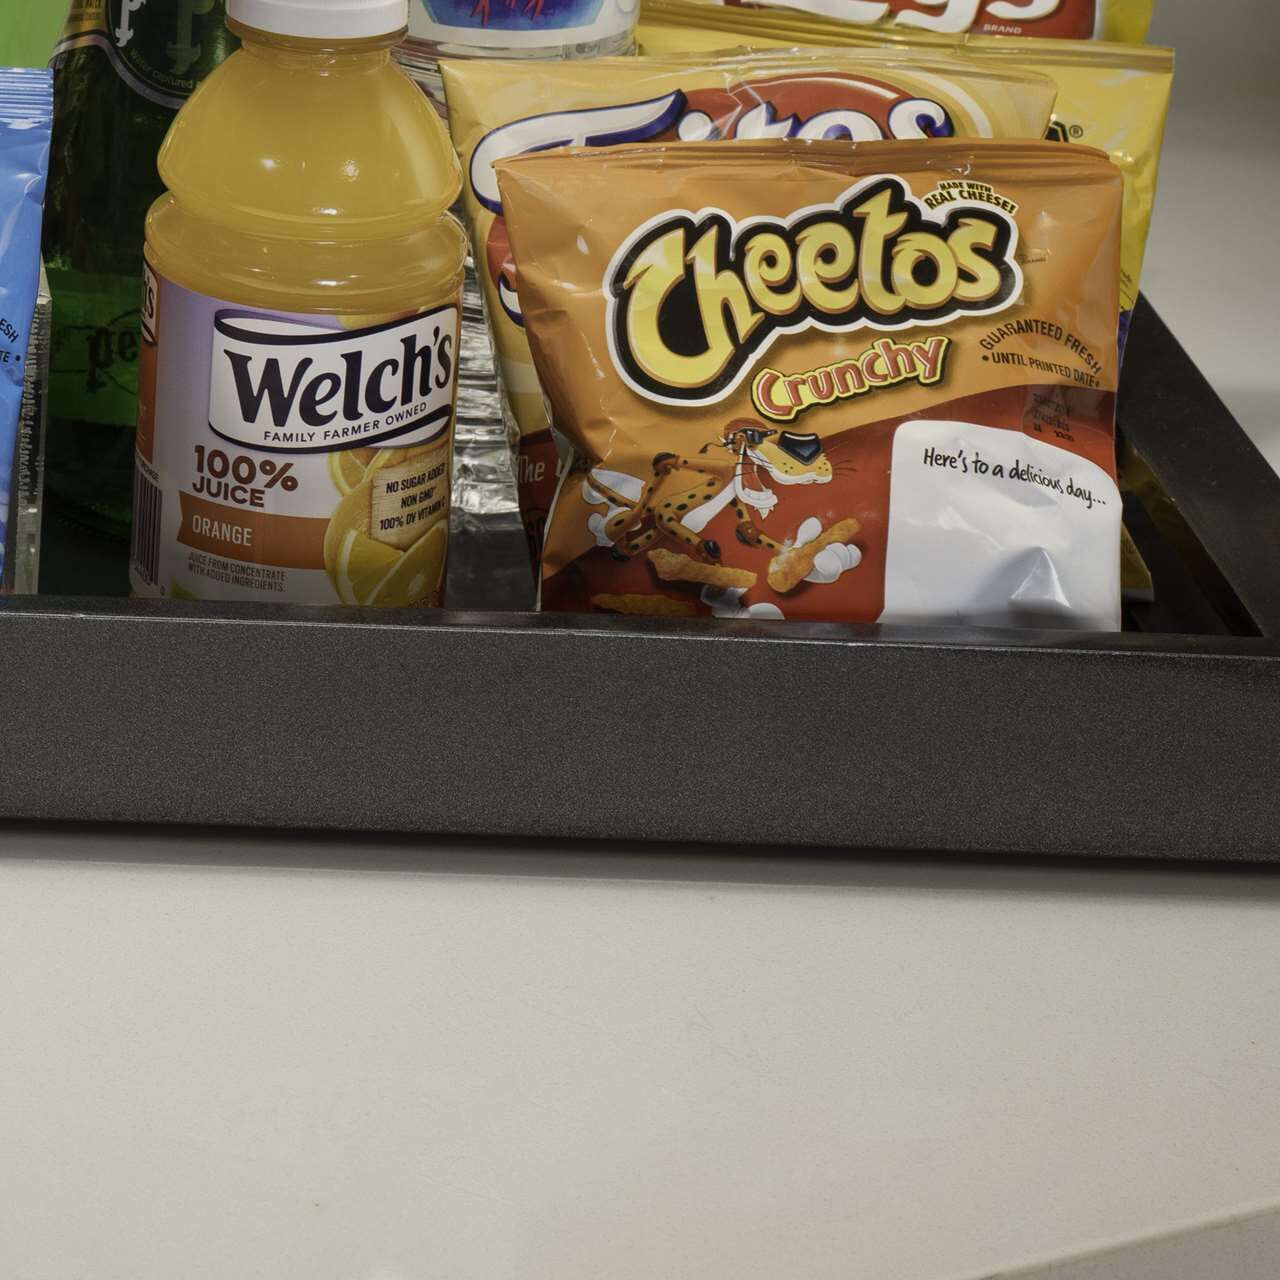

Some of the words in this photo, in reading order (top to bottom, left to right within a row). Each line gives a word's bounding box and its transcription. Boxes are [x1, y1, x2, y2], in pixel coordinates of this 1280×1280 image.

[982, 23, 1023, 35] BRAND
[924, 191, 957, 210] REAL
[958, 189, 1017, 214] CHEESE!
[939, 182, 965, 191] MADE
[966, 182, 992, 193] WITH
[623, 186, 1004, 388] Cheetos
[979, 319, 1063, 351] GUARANTEED
[1064, 332, 1102, 375] FRESH
[224, 325, 452, 427] Welch's
[756, 336, 947, 416] Crunchy
[992, 354, 1027, 367] UNTIL
[1028, 357, 1072, 378] PRINTED
[1073, 369, 1095, 386] DATE
[263, 430, 316, 443] FAMILY
[323, 419, 380, 441] FARMER
[385, 401, 428, 426] OWNED
[194, 444, 299, 492] 100%
[386, 481, 399, 494] NO
[400, 472, 426, 491] SUGAR
[923, 447, 968, 473] Here's
[972, 452, 989, 475] to
[992, 466, 1004, 478] a
[1009, 460, 1064, 495] delicious
[1066, 478, 1106, 509] day...
[192, 476, 267, 509] JUICE
[400, 495, 417, 509] NON
[192, 514, 252, 546] ORANGE
[380, 515, 404, 531] 100%
[406, 511, 417, 525] DV
[207, 556, 229, 571] FROM
[230, 564, 288, 581] CONCENTRATE
